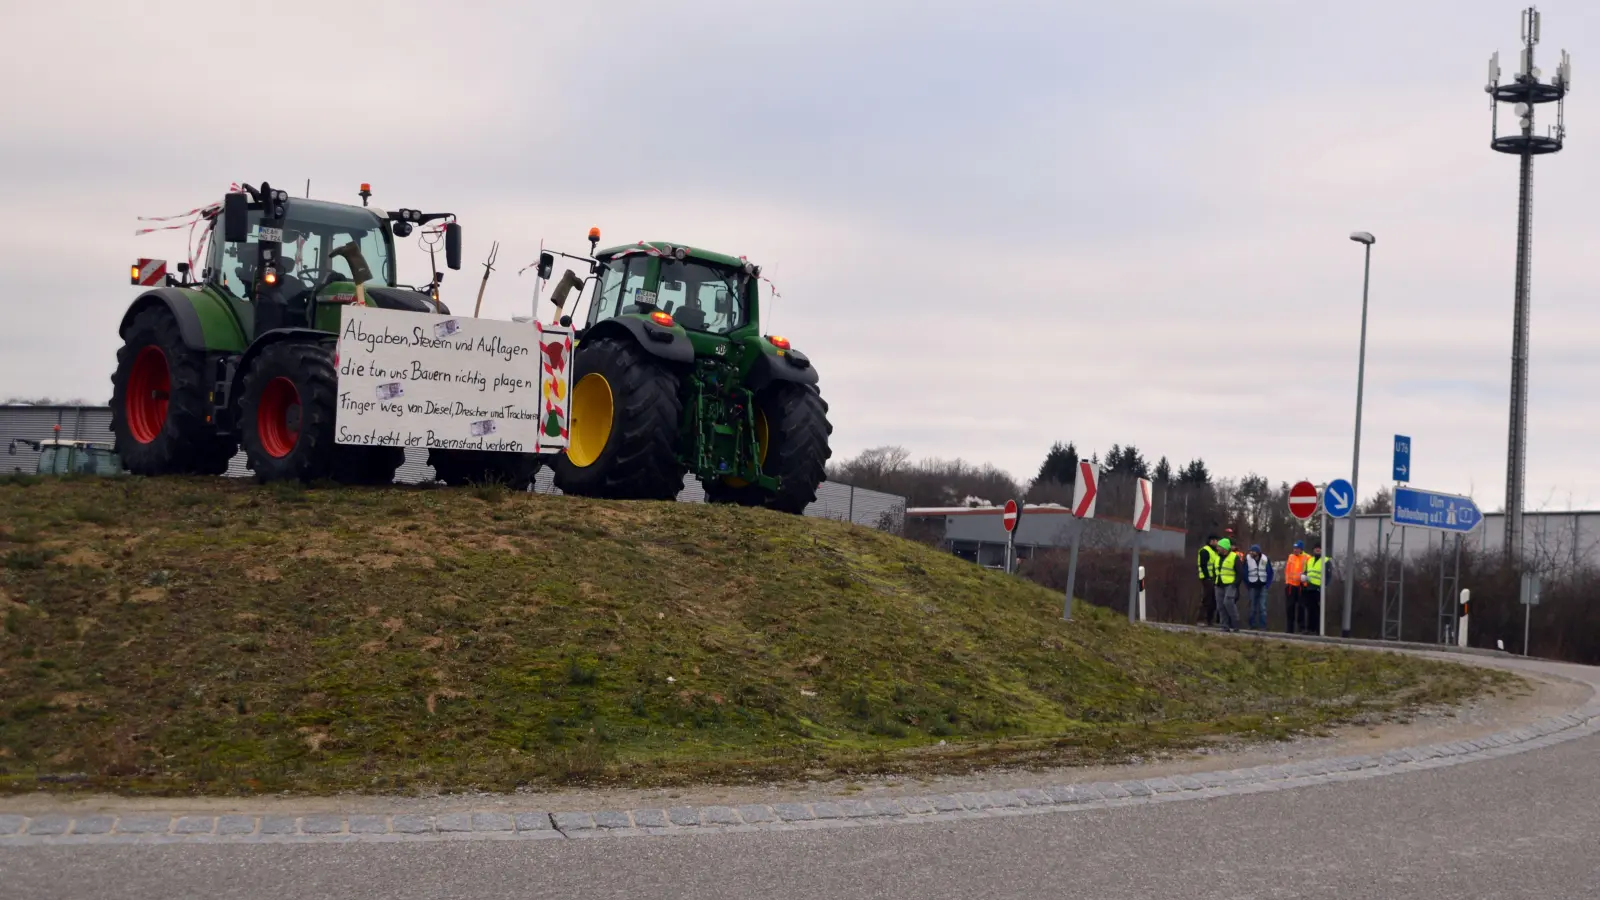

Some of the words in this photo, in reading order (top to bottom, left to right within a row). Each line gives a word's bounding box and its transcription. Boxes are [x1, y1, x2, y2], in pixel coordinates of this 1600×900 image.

[455, 339, 473, 351] und
[476, 336, 529, 361] Auflagen
[340, 358, 365, 377] die
[369, 361, 387, 378] tun
[389, 368, 408, 380] uns
[410, 360, 451, 382] Bauern
[455, 371, 486, 392] richtig
[493, 372, 532, 393] plagen
[339, 391, 376, 416] Finger
[380, 402, 404, 417] weg
[407, 403, 423, 414] von
[490, 406, 505, 419] und
[404, 431, 423, 446] der
[426, 429, 483, 451] Bauernstand
[485, 438, 523, 452] verloren
[1429, 495, 1445, 508] Ulm
